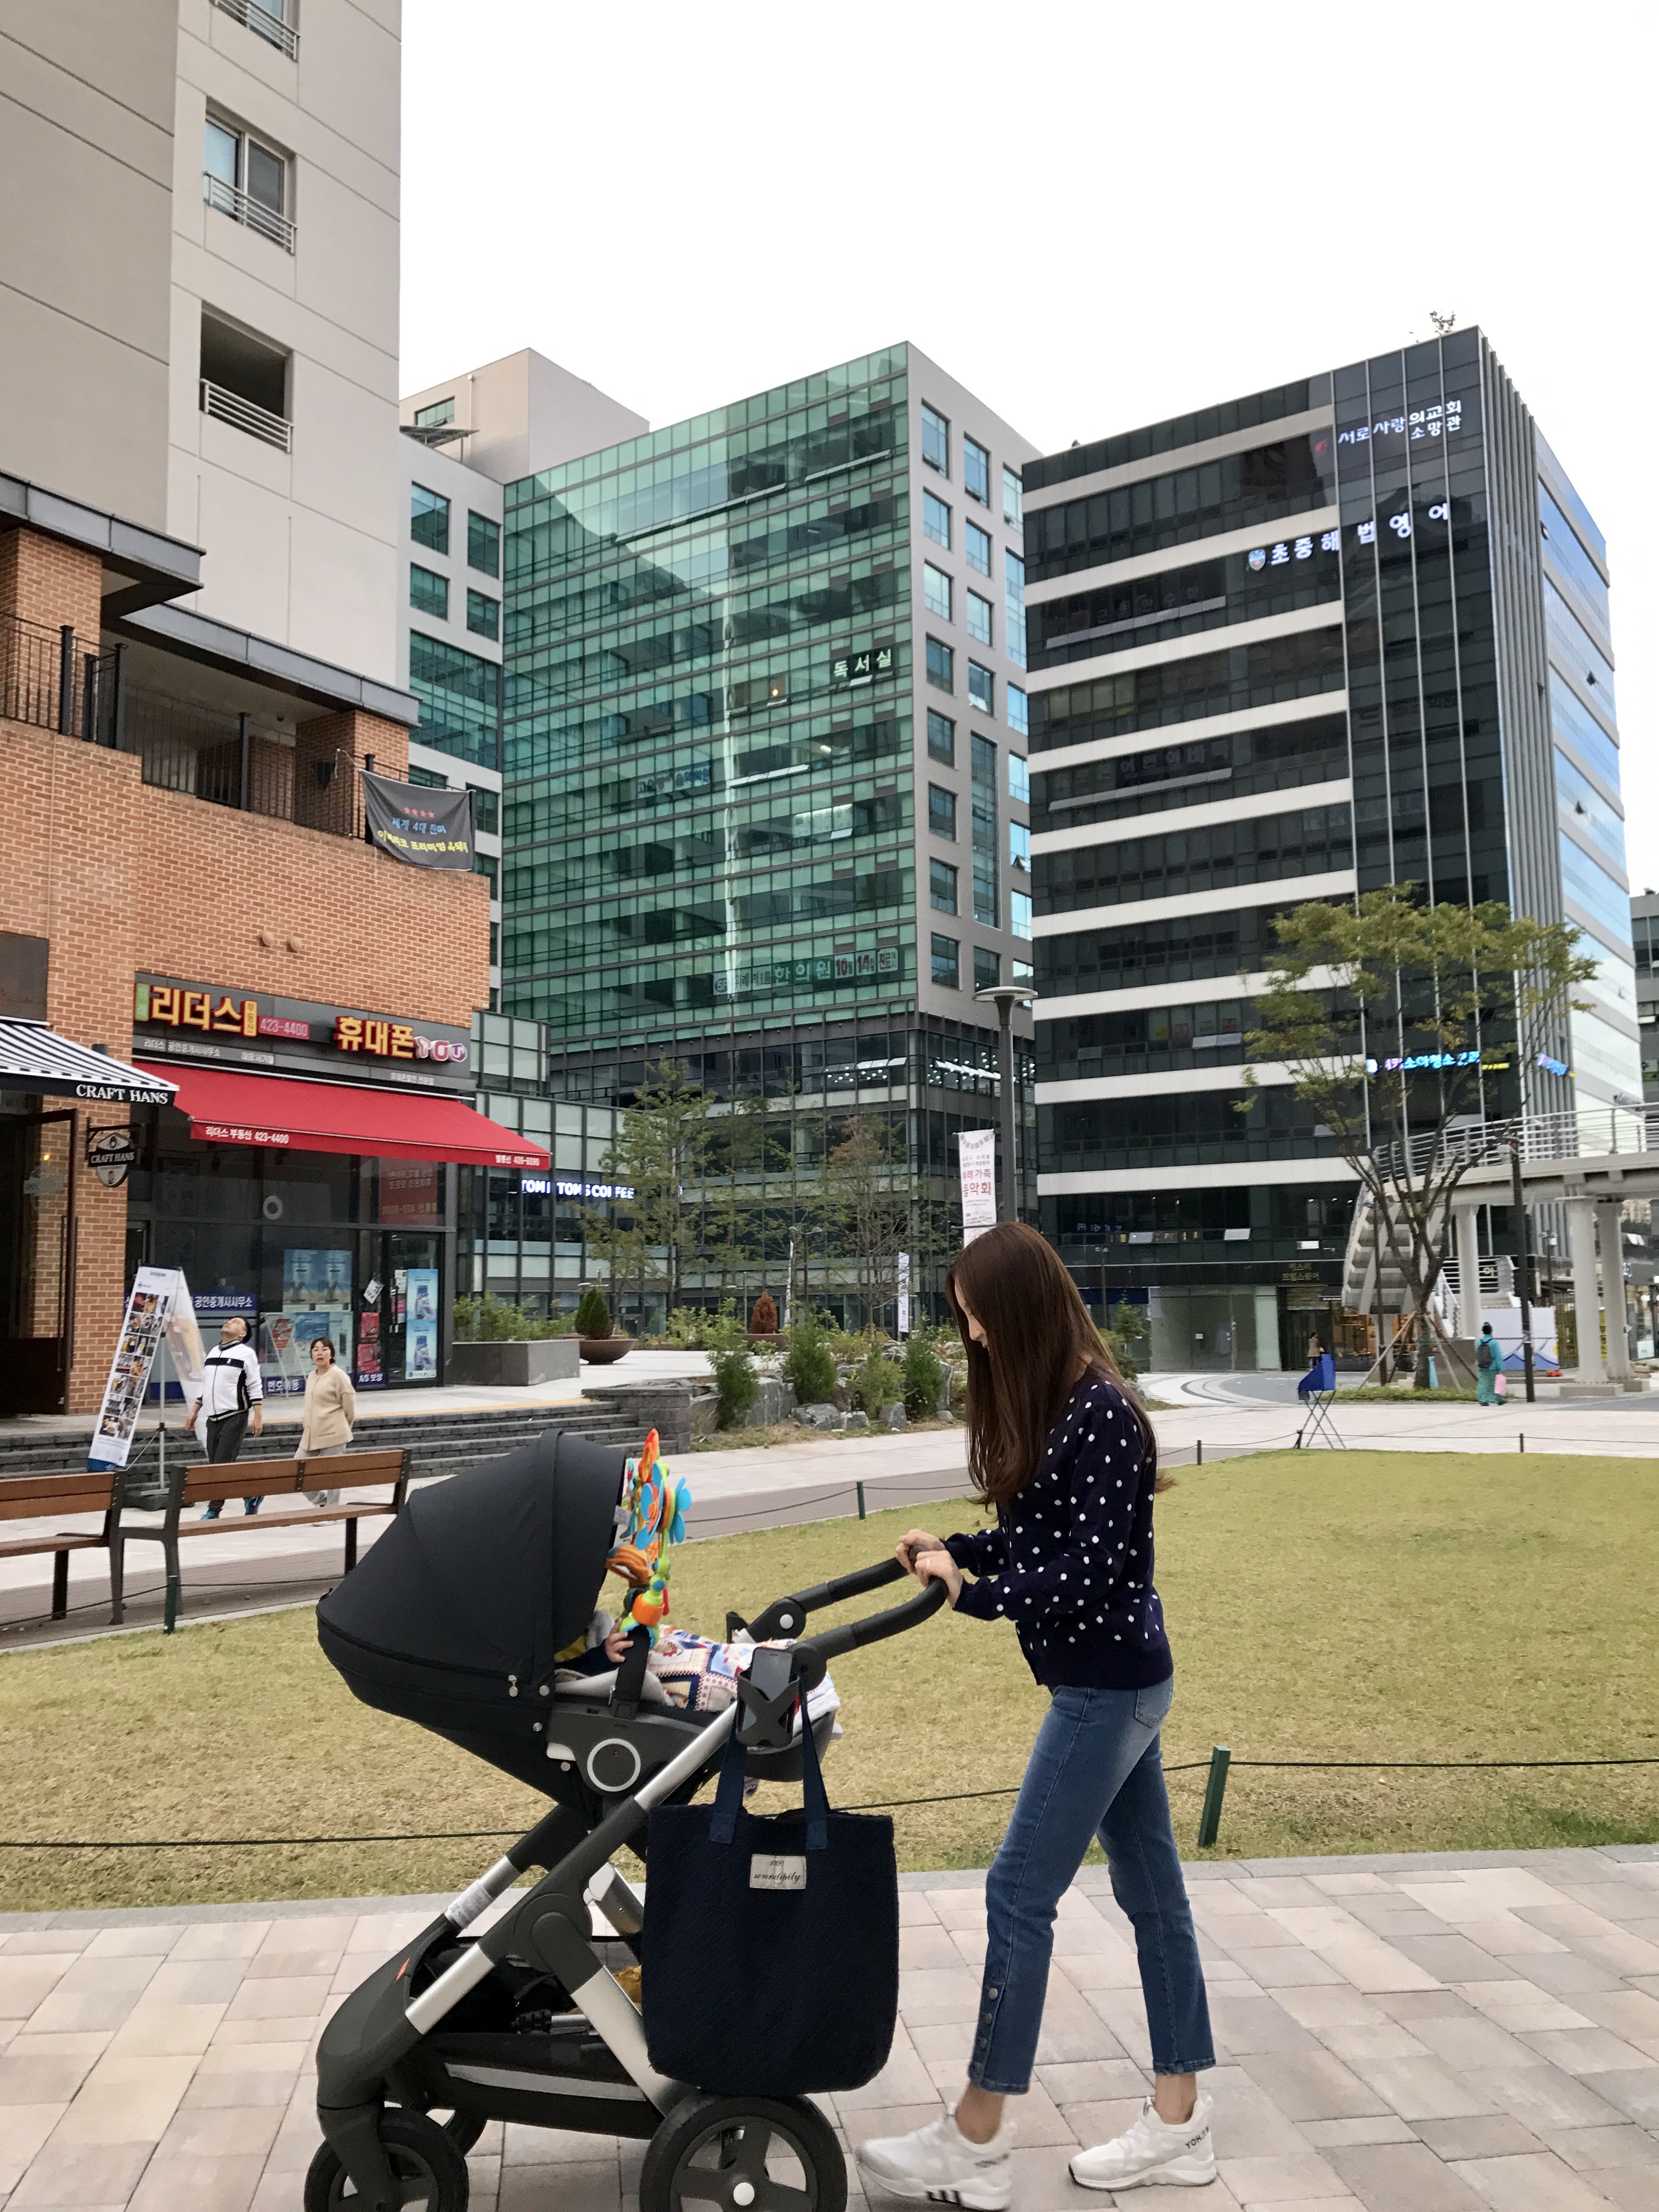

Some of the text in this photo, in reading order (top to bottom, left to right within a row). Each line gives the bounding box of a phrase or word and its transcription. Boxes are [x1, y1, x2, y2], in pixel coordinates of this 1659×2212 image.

[1410, 415, 1462, 439] 소망관
[834, 648, 891, 678] 독서실
[775, 960, 831, 986] 한의원
[151, 985, 242, 1032] 리더스
[259, 1018, 308, 1036] 423-4400
[337, 1016, 414, 1059] 휴대폰
[76, 1084, 169, 1104] CRAFT HANS
[963, 1182, 992, 1198] 음악회
[194, 1296, 253, 1308] 공인중개사사무소
